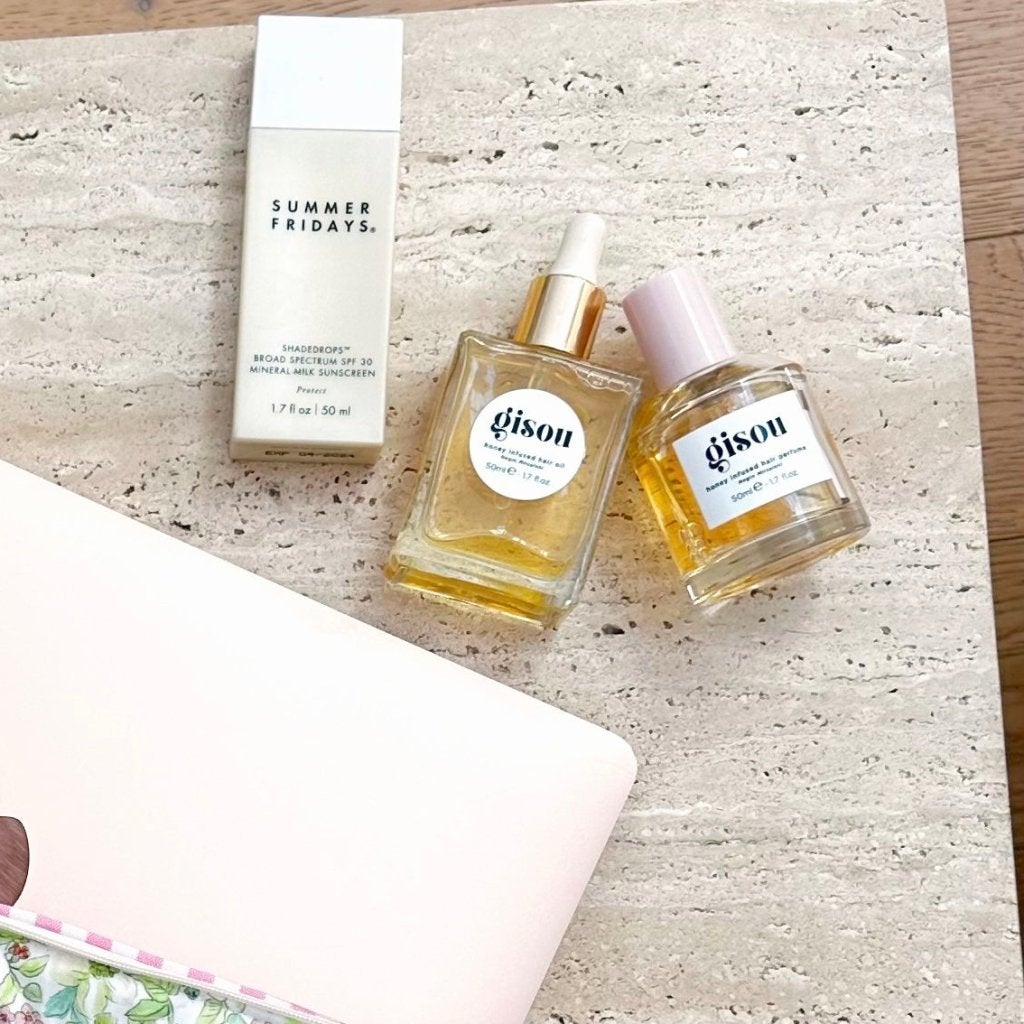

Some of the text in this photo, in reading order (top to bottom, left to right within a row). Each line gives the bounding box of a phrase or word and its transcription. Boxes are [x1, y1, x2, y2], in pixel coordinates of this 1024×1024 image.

[272, 199, 370, 215] SUMMER
[253, 354, 373, 366] BROAD SPECTRUM SPF 30
[249, 365, 376, 377] MINERAL MILK SUNSCREEN
[296, 385, 327, 395] Protect
[298, 406, 311, 415] oz
[321, 405, 336, 416] 50
[339, 406, 351, 416] ml
[490, 407, 574, 448] gisou
[705, 416, 788, 473] gisou
[483, 442, 507, 454] honey
[538, 456, 554, 465] hair
[706, 478, 728, 493] honey
[729, 463, 759, 480] infused
[760, 457, 777, 467] hair
[778, 445, 807, 462] perfume
